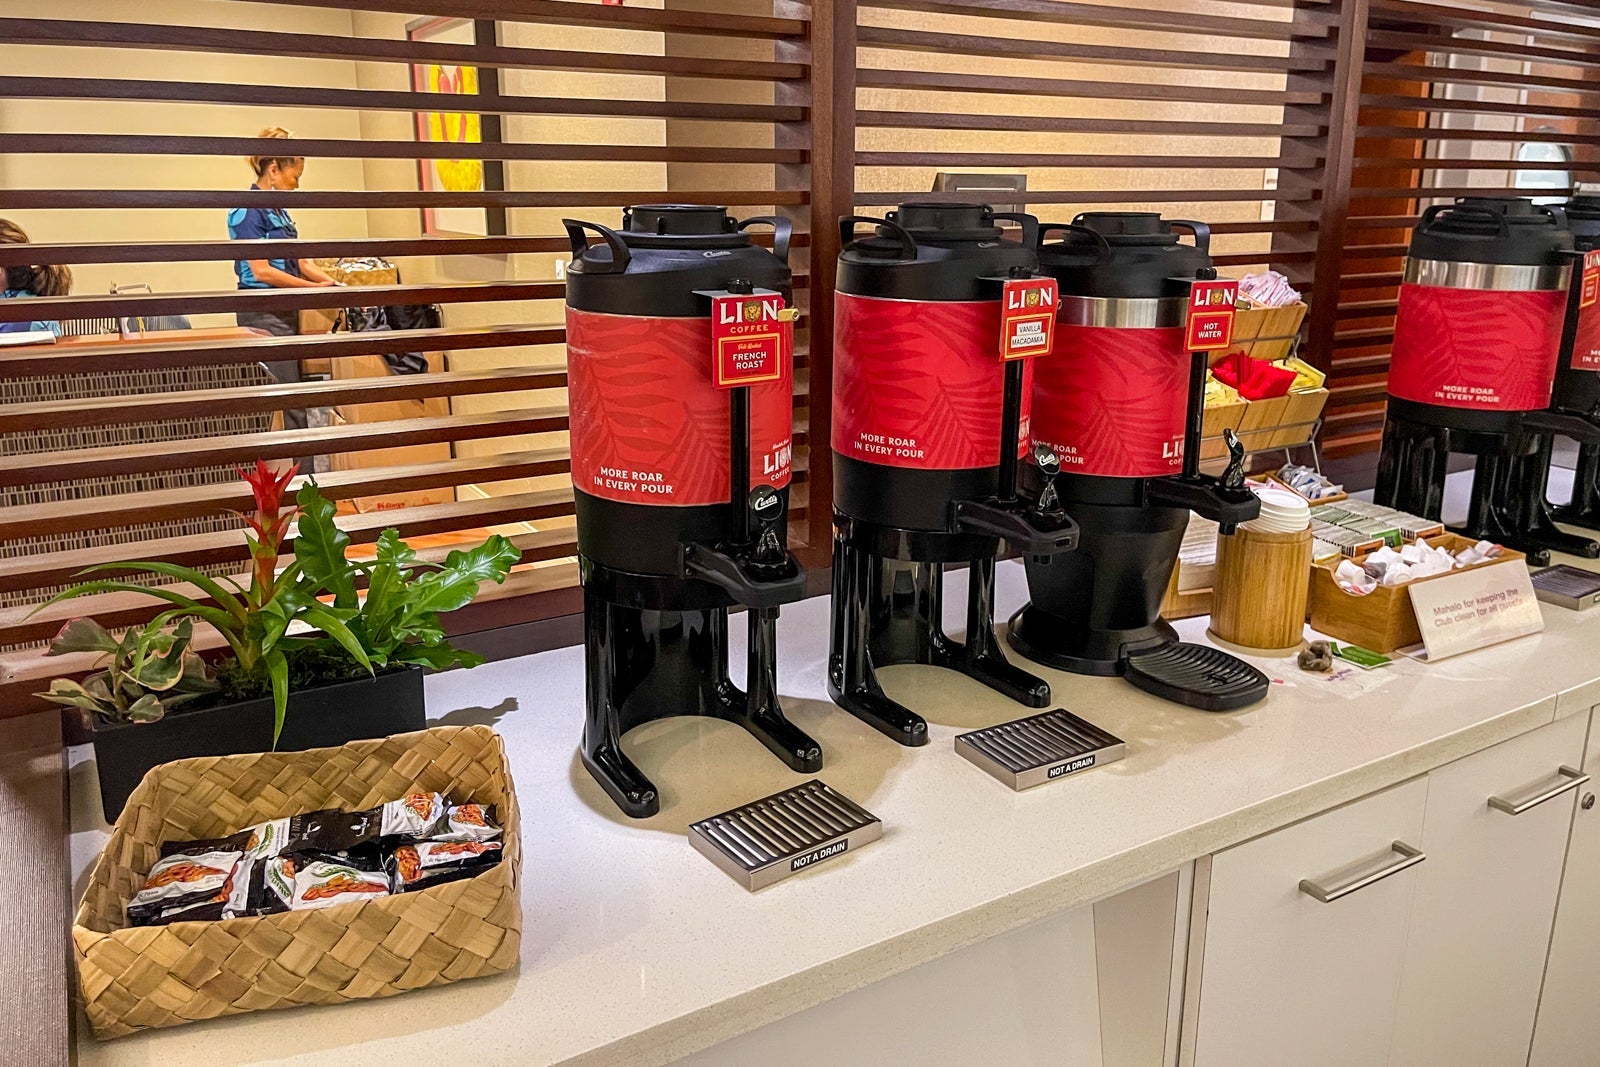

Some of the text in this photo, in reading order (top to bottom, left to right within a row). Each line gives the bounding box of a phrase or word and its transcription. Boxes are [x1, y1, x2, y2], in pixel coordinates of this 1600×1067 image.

[730, 324, 769, 334] COFFEE
[1018, 324, 1041, 333] VANILLA
[1203, 322, 1219, 330] HOT
[1198, 330, 1222, 339] WATER
[1012, 335, 1044, 346] MACADAMIA
[733, 352, 767, 361] FRENCH
[736, 360, 764, 370] ROAST
[1442, 385, 1494, 395] MORE ROAR
[1446, 392, 1474, 401] EVERY
[1475, 395, 1500, 403] POUR
[860, 432, 916, 448] MORE ROAR
[854, 440, 924, 459] IN EVERY POUR
[1053, 444, 1077, 455] ROAR
[1059, 454, 1084, 465] POUR
[600, 466, 663, 482] MORE ROAR
[594, 476, 673, 494] IN EVERY POUR
[1433, 588, 1519, 616] Mahalo for keeping the
[1434, 616, 1452, 628] Club
[1455, 611, 1475, 623] clean
[1476, 607, 1487, 617] for
[1489, 604, 1498, 614] all
[1049, 756, 1093, 777] NOT A DRAIN
[793, 842, 845, 869] NOT A DRAIN
